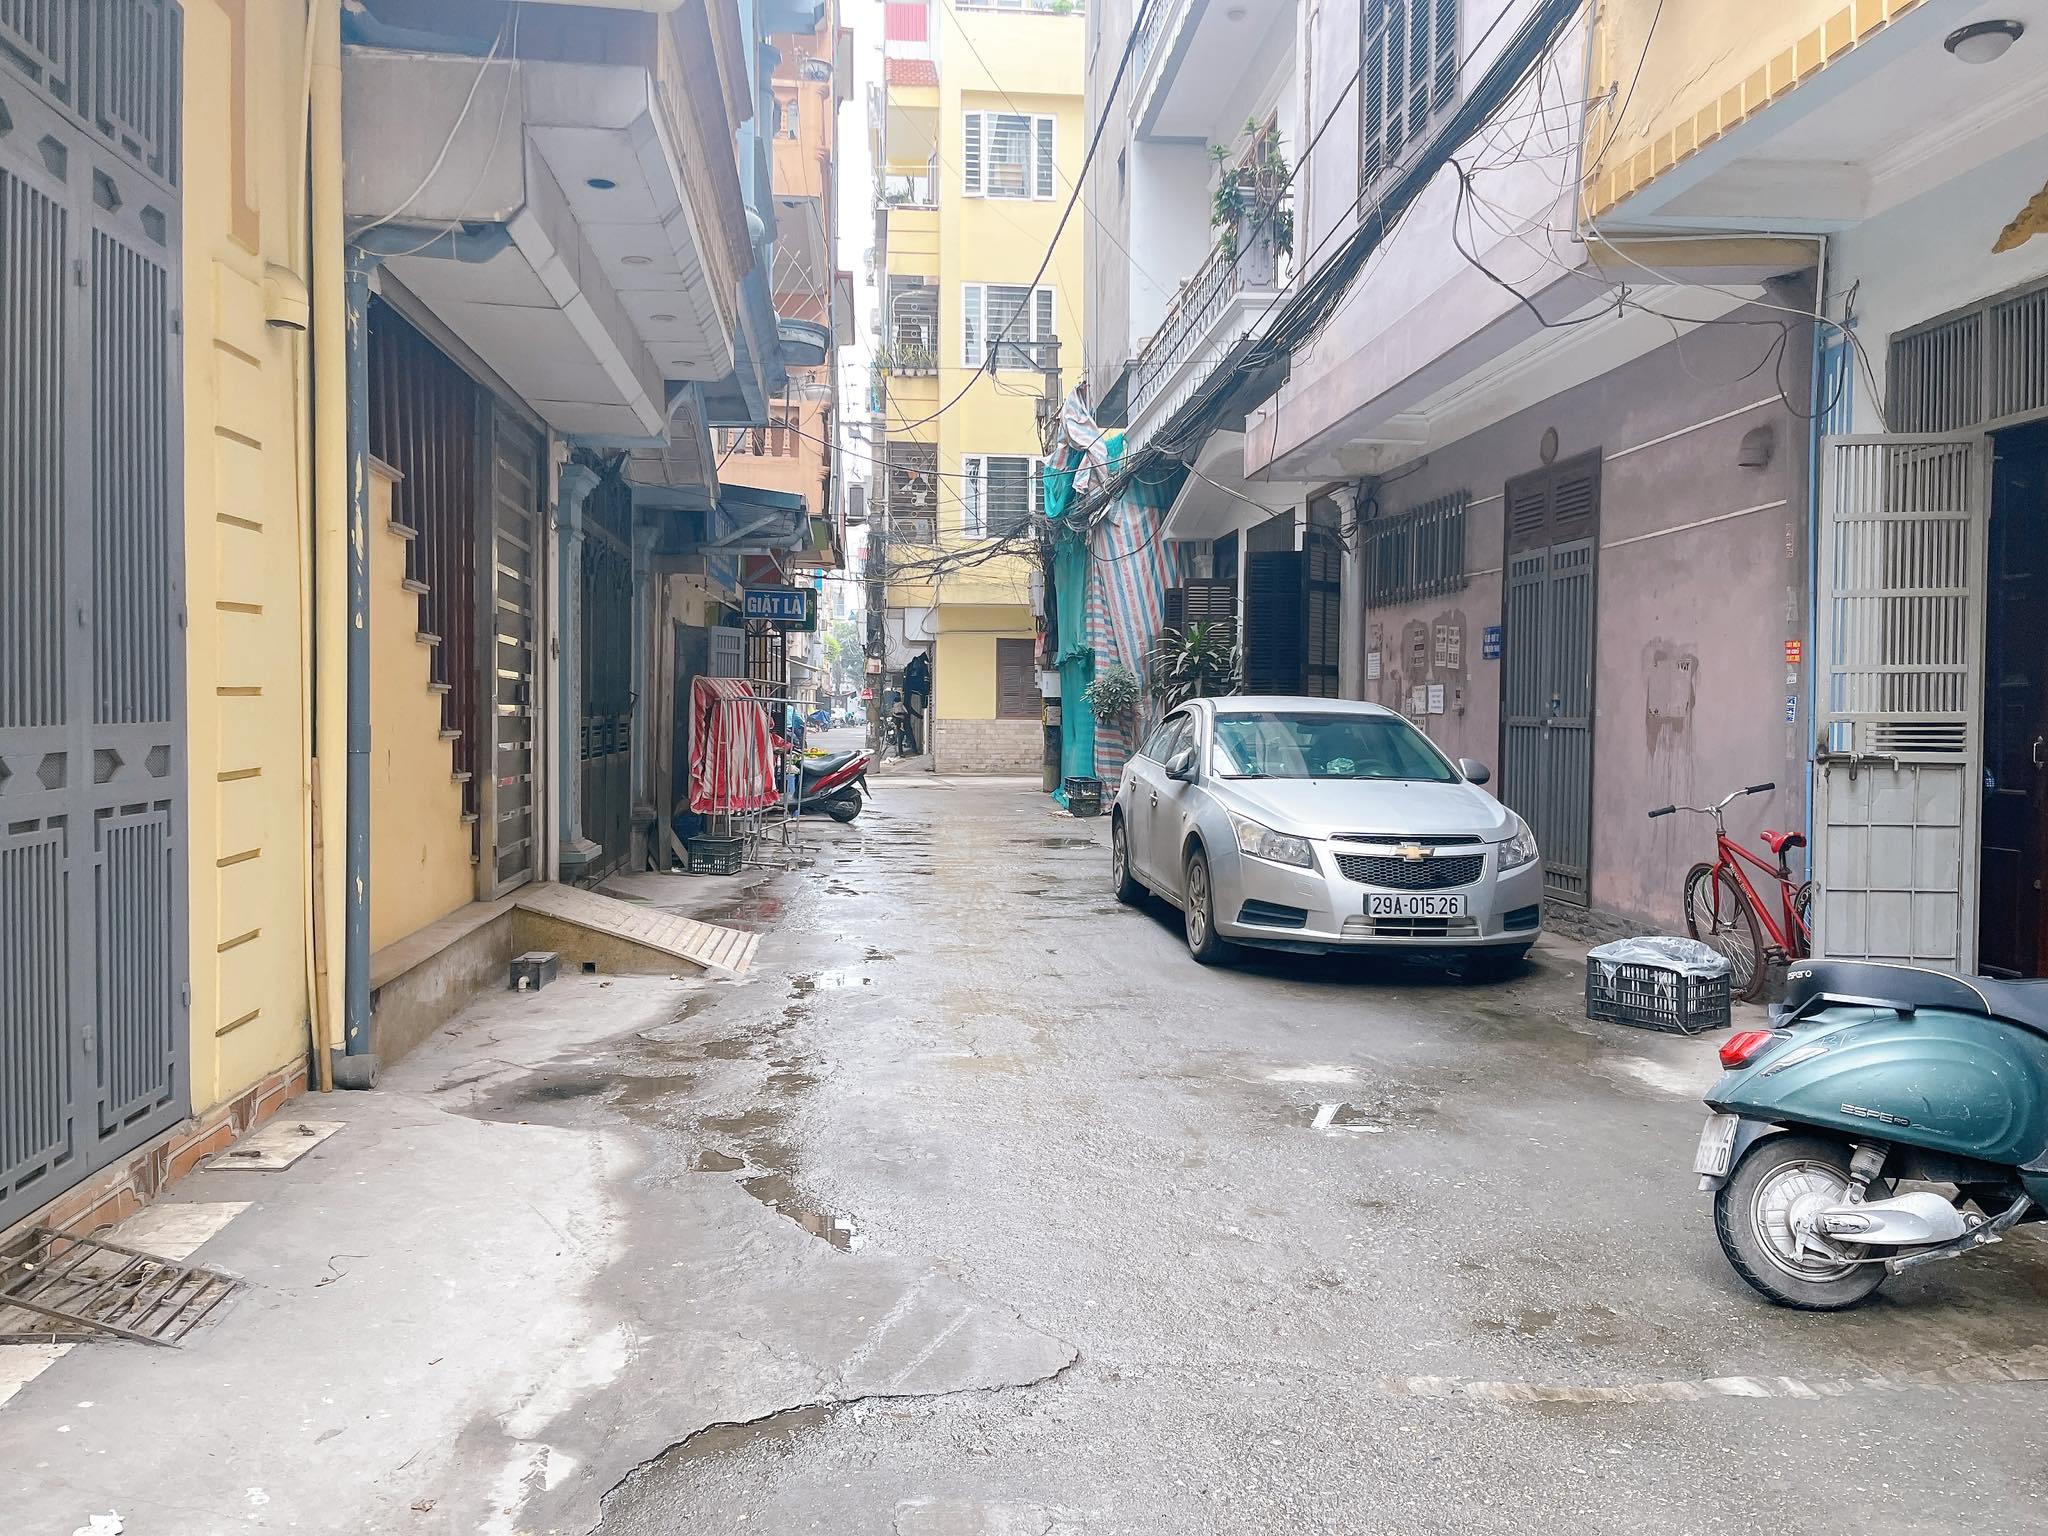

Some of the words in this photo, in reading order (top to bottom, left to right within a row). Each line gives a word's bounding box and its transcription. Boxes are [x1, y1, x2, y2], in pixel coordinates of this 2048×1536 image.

[747, 595, 780, 617] GIẶT
[784, 595, 802, 615] LÀ
[1372, 896, 1459, 915] 29A-015.26
